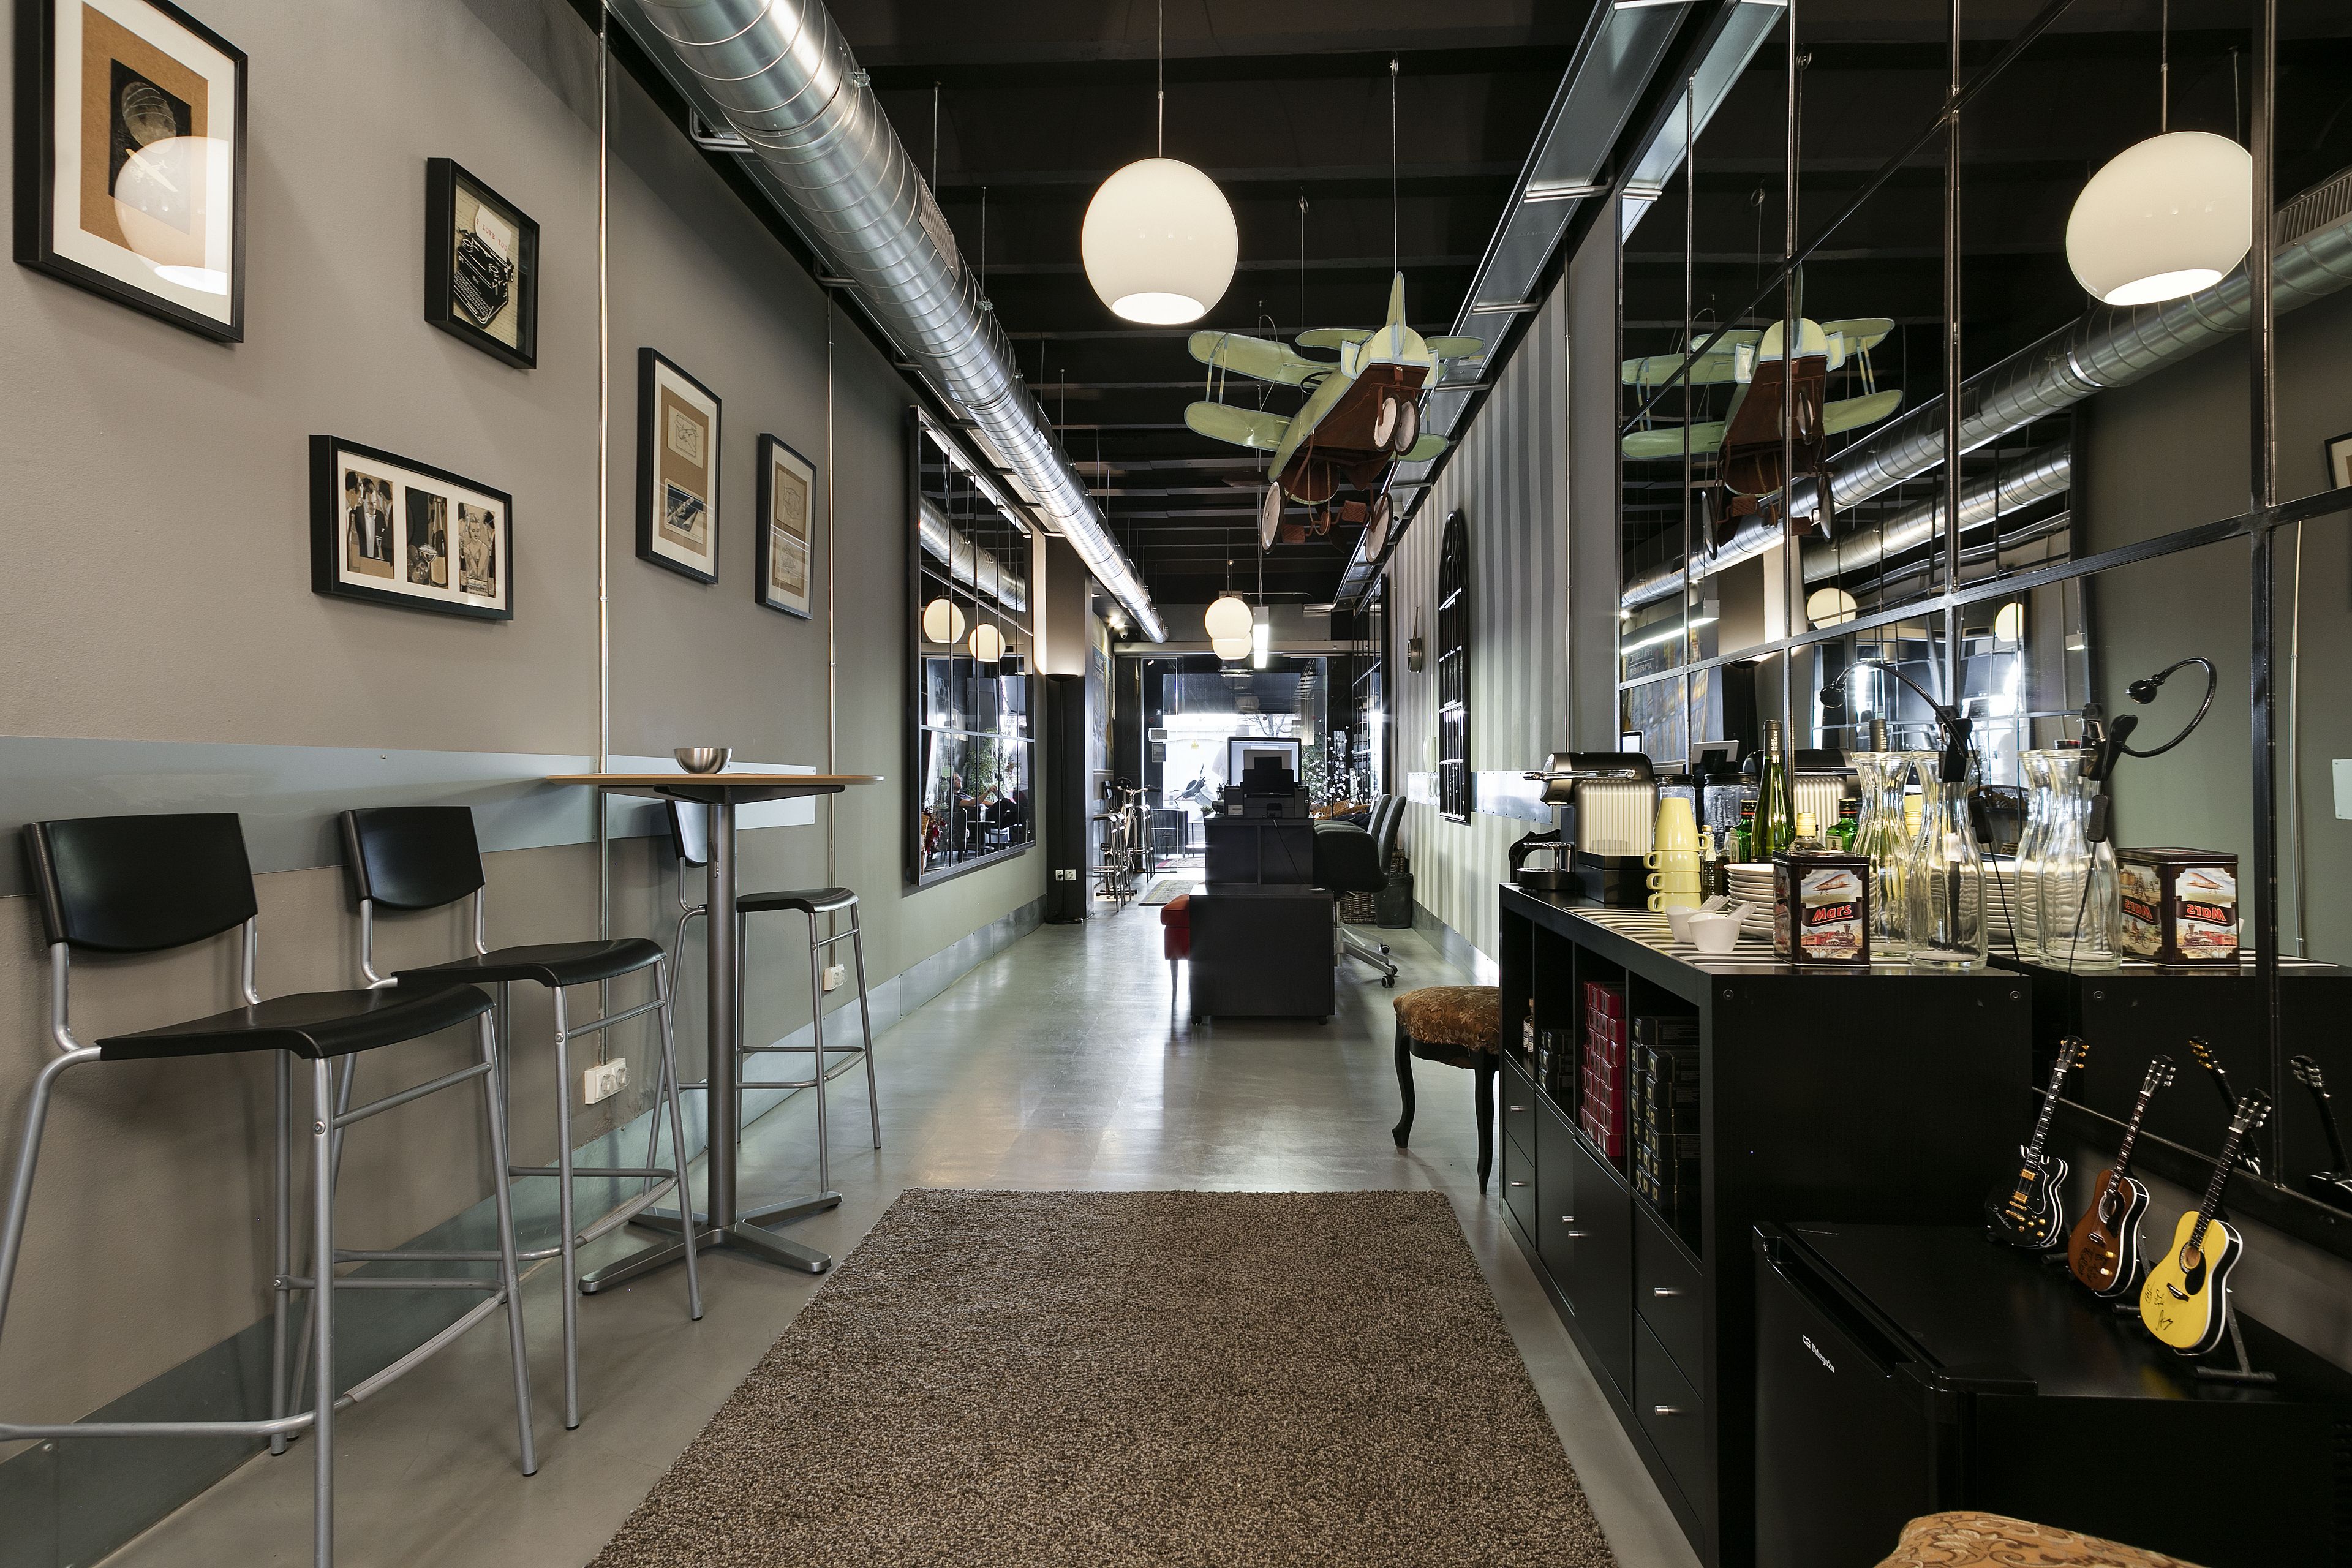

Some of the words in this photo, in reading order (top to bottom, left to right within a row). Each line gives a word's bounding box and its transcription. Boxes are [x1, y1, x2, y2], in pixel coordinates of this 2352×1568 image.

[483, 224, 496, 239] LOVE
[498, 239, 508, 251] YOU
[1812, 905, 1852, 922] Mars
